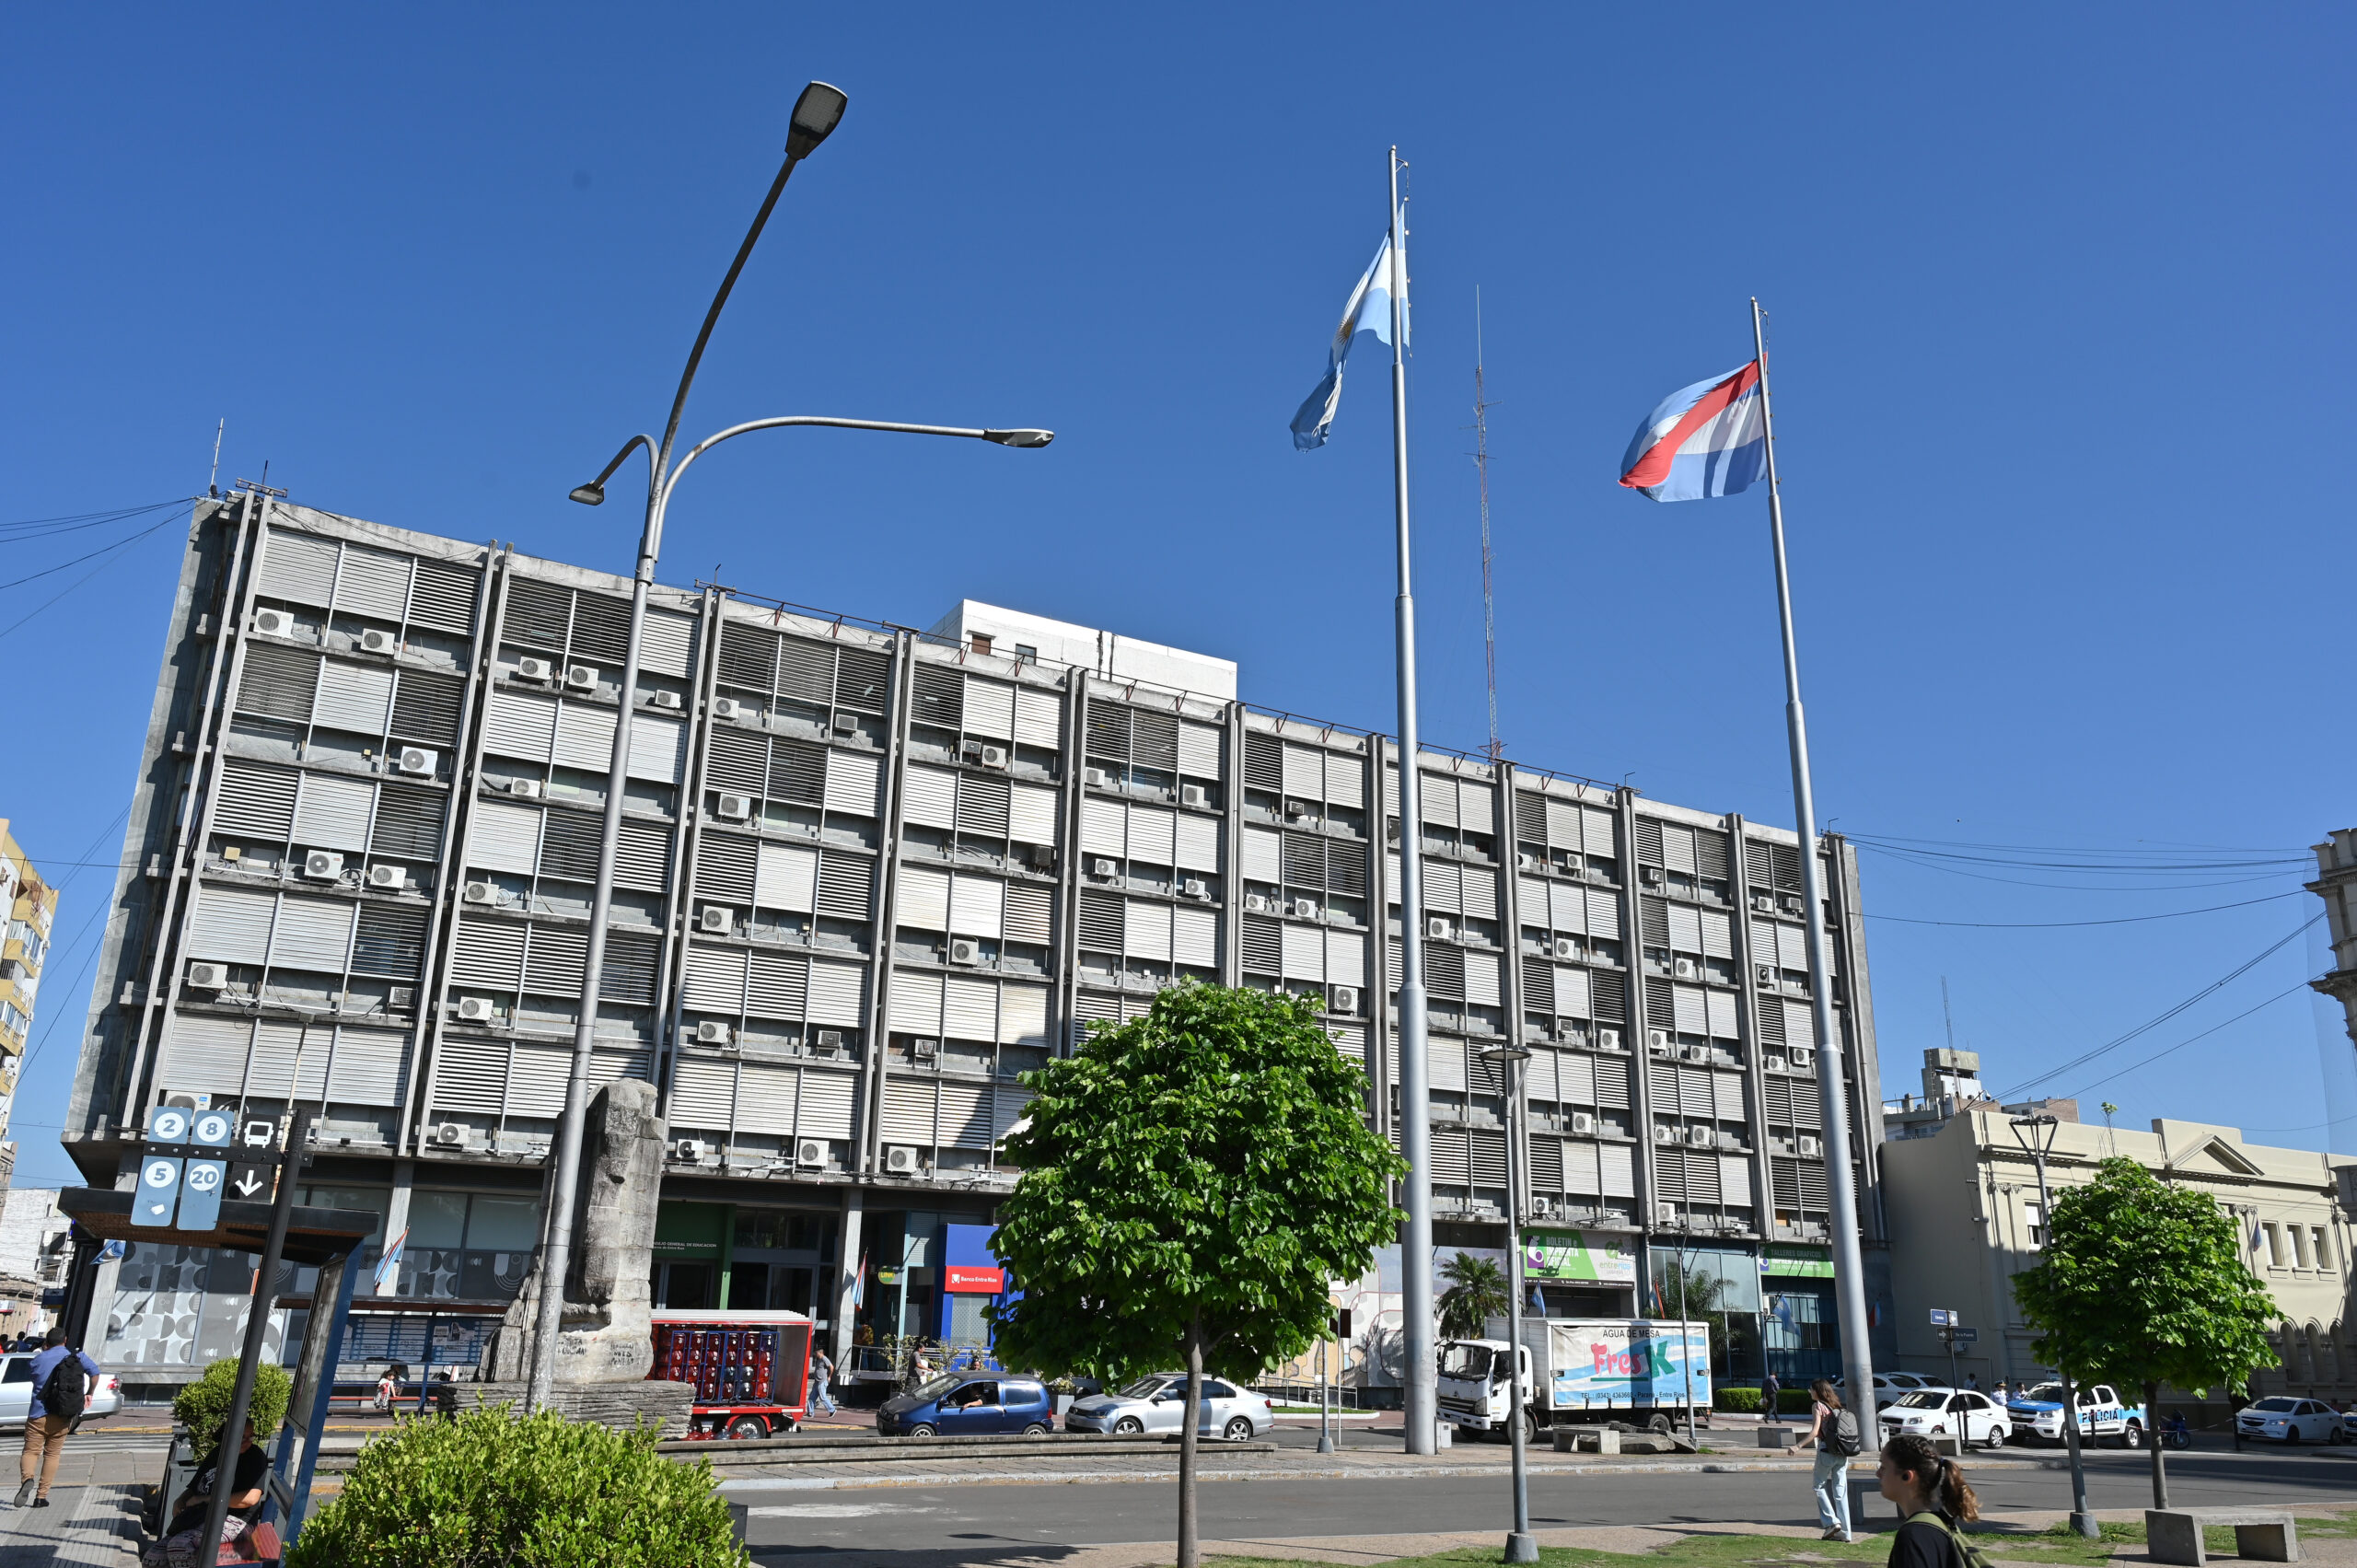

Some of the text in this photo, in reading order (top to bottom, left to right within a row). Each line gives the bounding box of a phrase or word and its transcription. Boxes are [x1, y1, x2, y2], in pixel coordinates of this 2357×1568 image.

[163, 1119, 176, 1132] 2
[205, 1122, 218, 1135] 8
[154, 1167, 167, 1181] 5
[191, 1170, 217, 1184] 20
[1602, 1330, 1661, 1339] AGUA DE MESA
